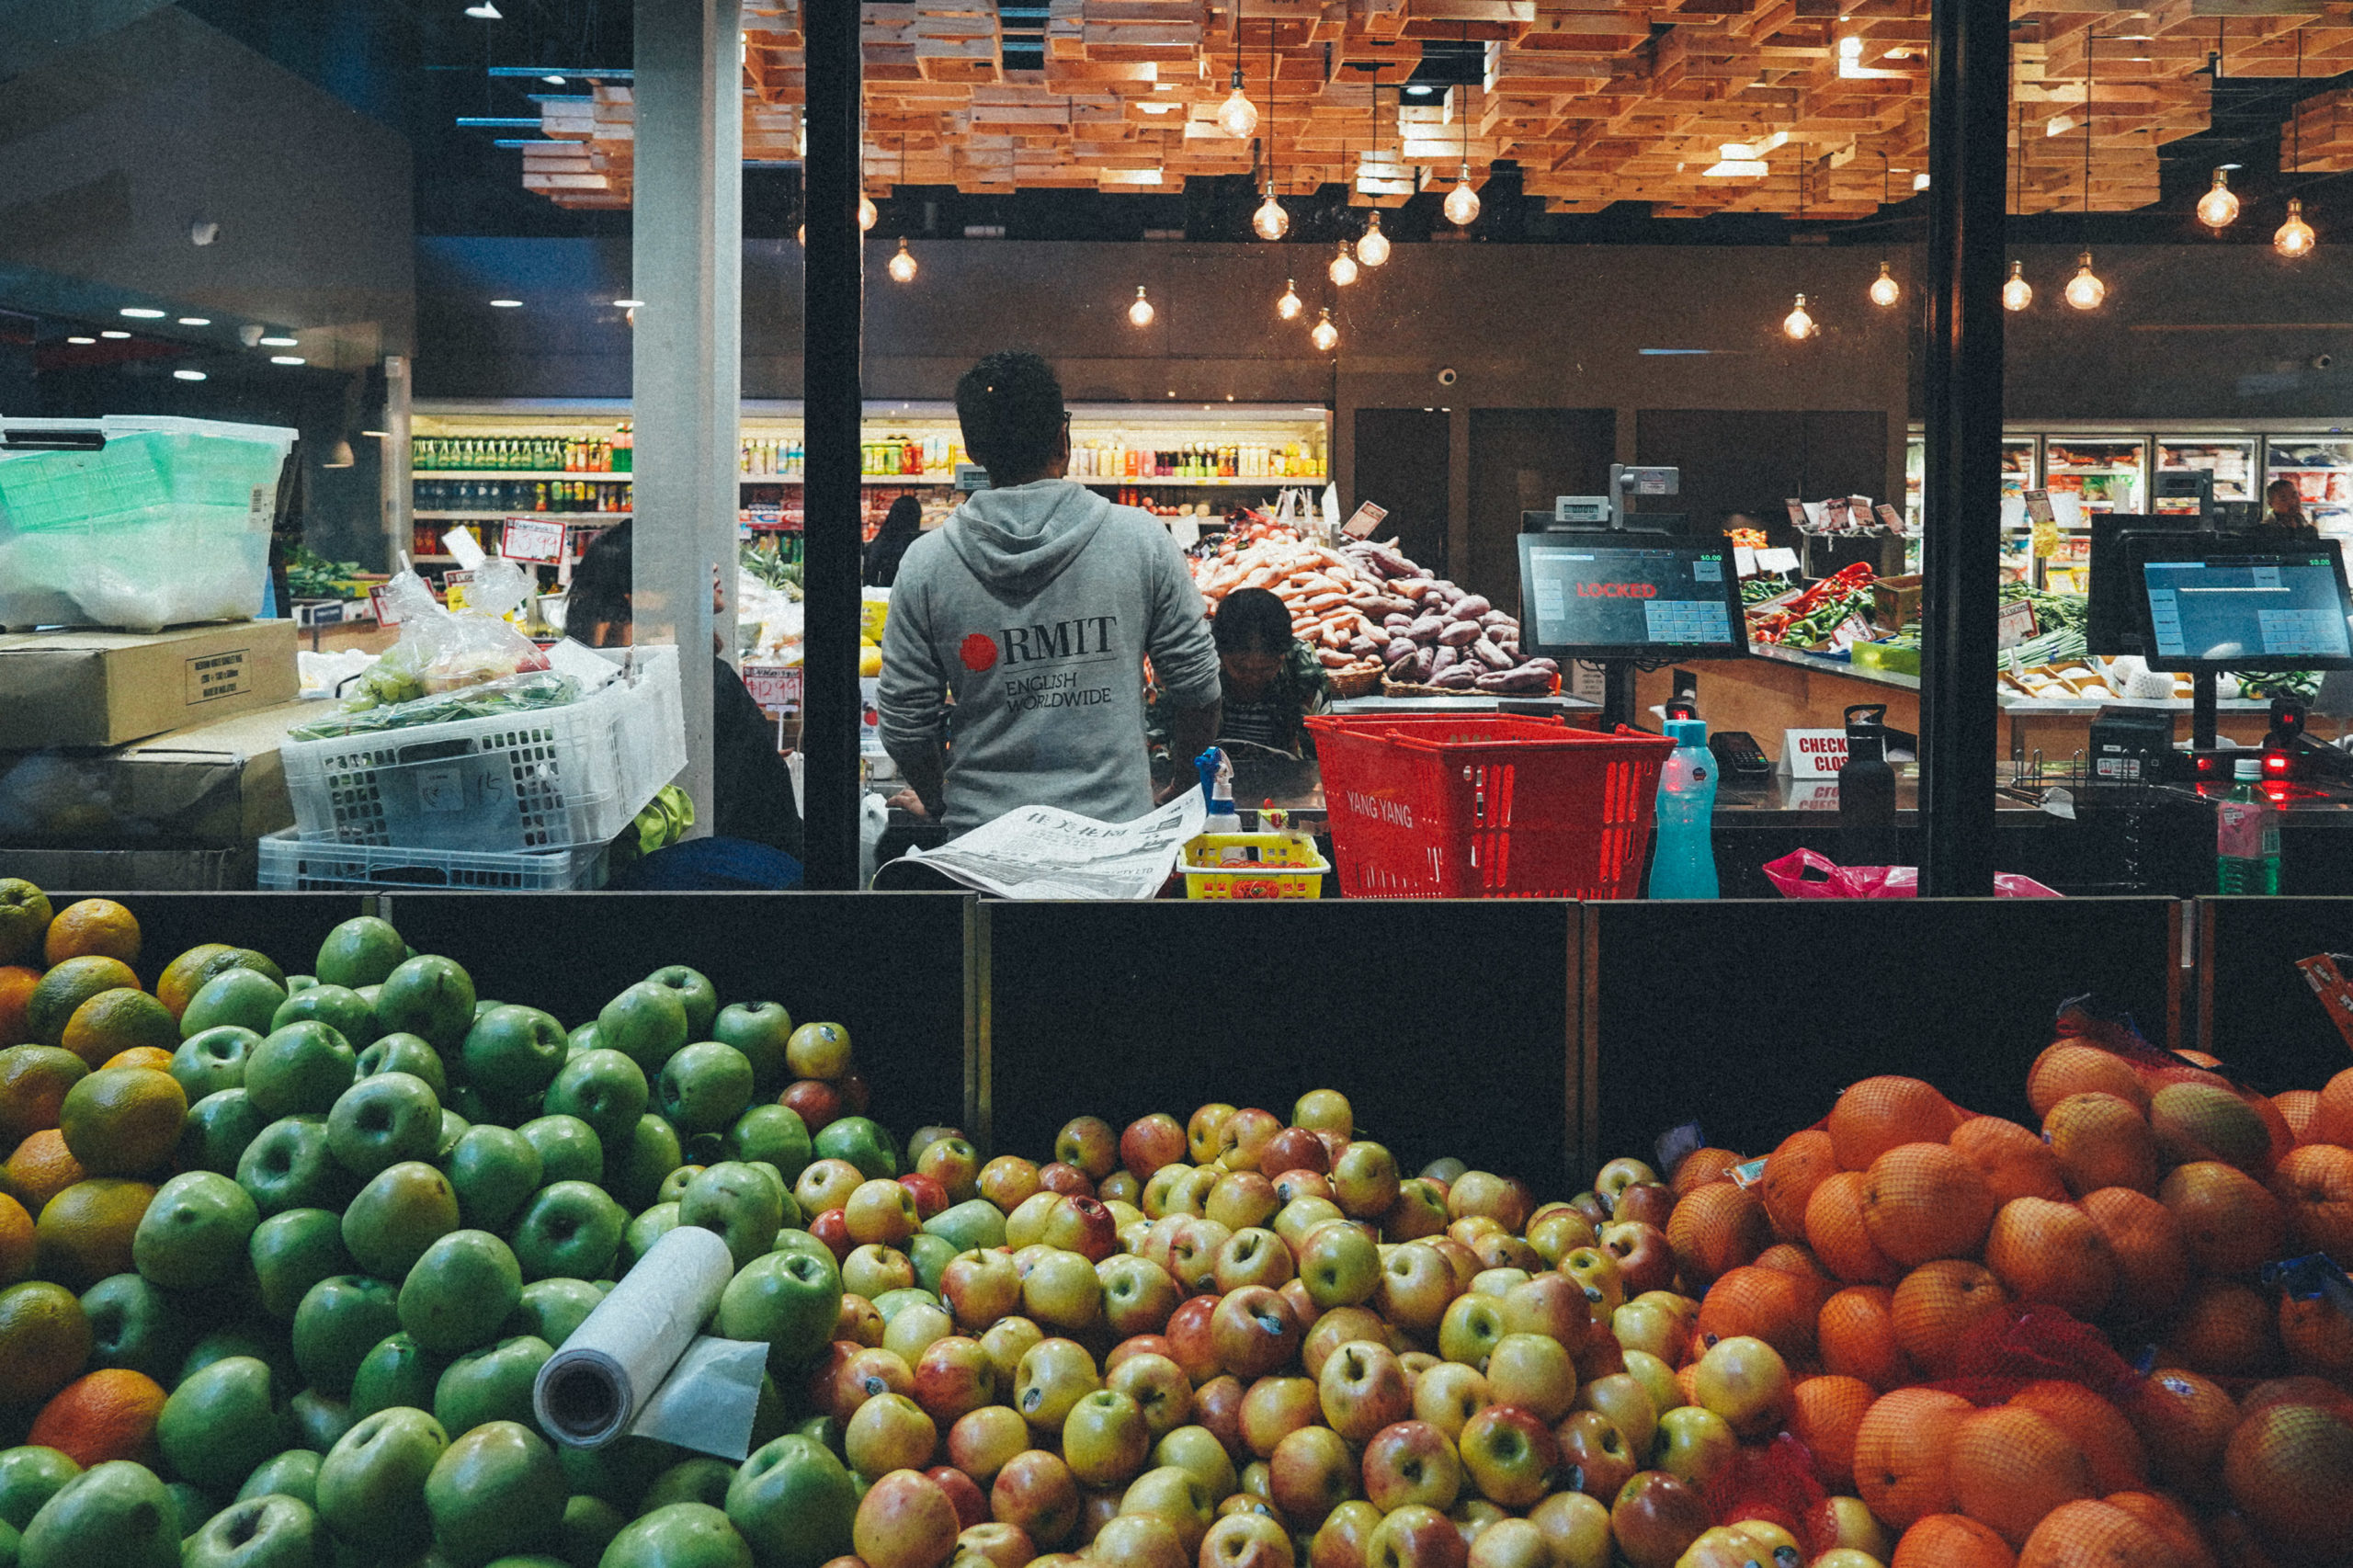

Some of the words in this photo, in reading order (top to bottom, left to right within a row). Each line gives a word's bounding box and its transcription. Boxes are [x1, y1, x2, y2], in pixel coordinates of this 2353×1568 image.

[1576, 583, 1656, 597] LOCKED
[999, 616, 1118, 665] RMIT
[1005, 672, 1077, 697] ENGLISH
[1006, 687, 1111, 714] WORLDWIDE
[1799, 737, 1848, 754] CHECK
[1814, 756, 1849, 772] CLOS
[1347, 790, 1378, 820] YANG
[1380, 799, 1414, 830] YANG
